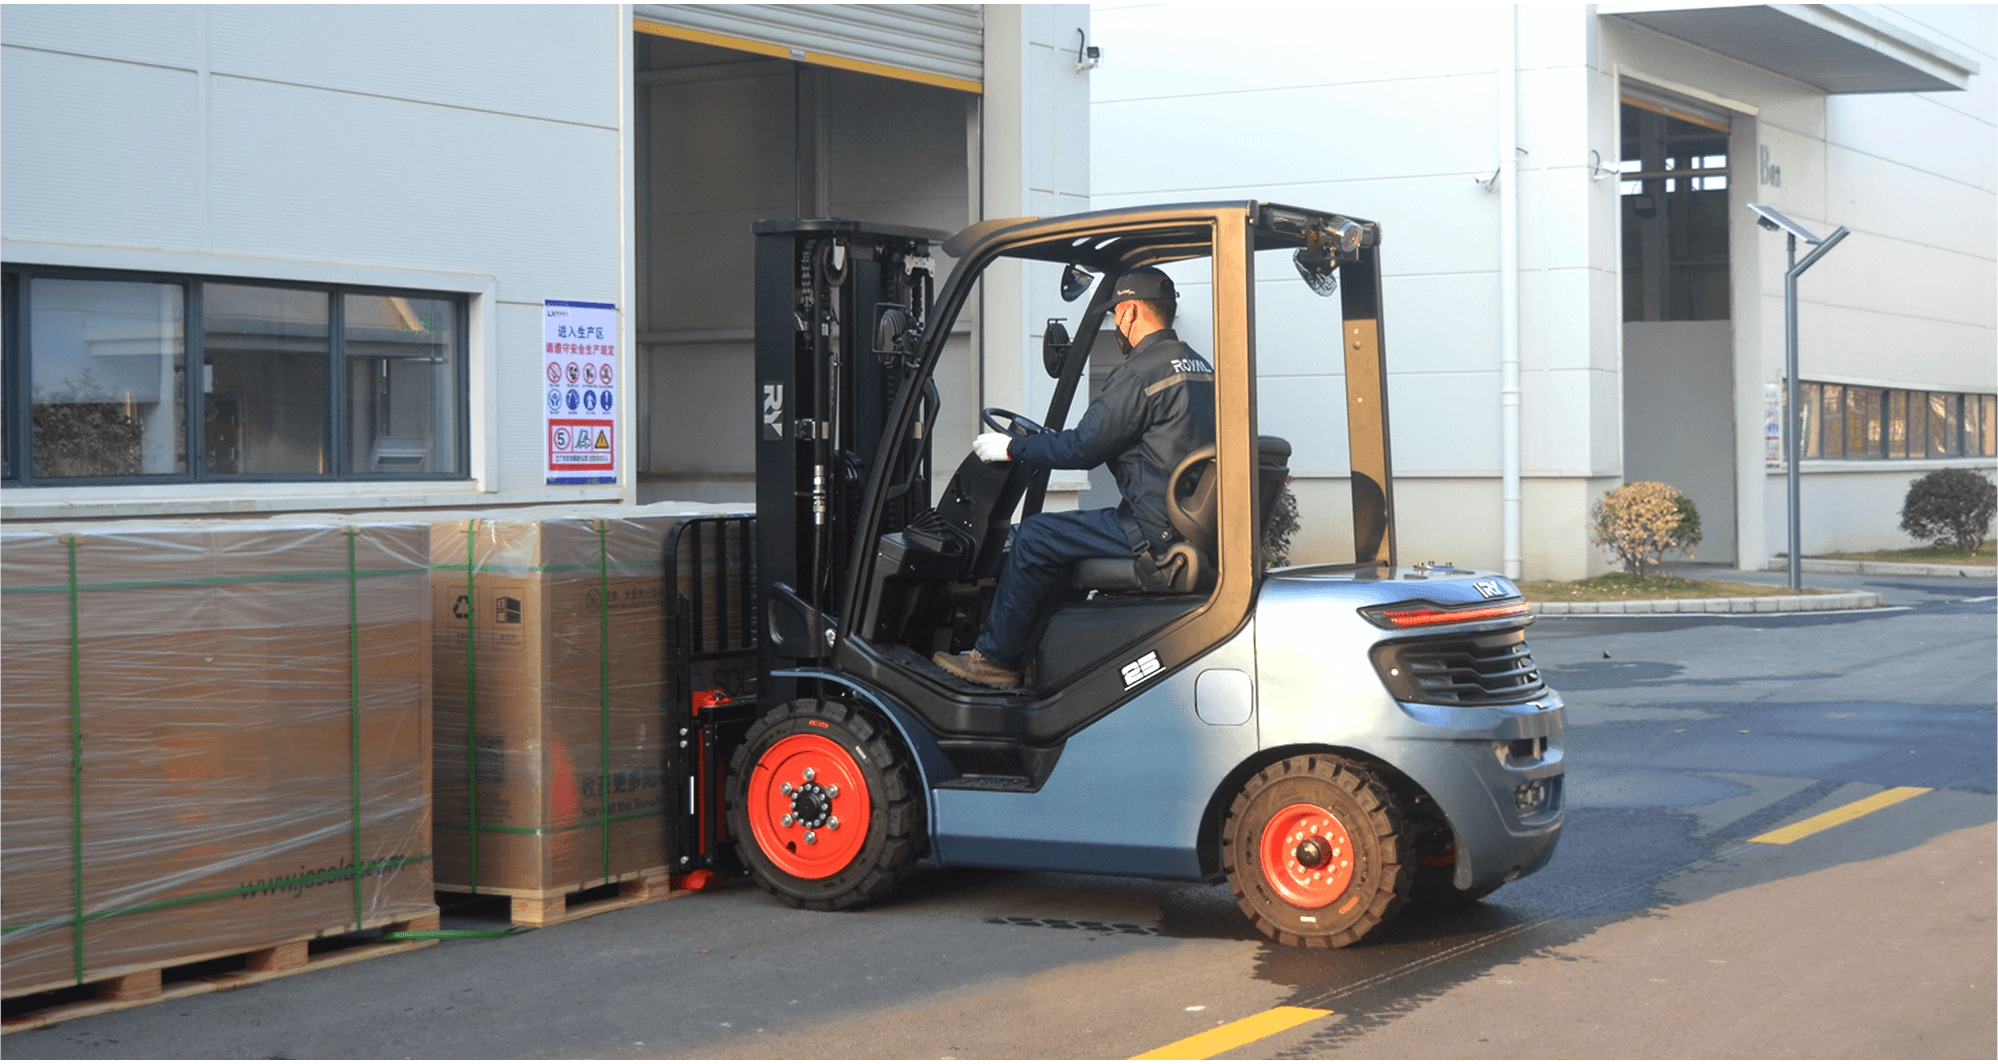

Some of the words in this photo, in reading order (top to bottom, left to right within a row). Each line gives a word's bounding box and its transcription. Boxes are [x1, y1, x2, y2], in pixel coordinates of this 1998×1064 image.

[558, 325, 604, 340] 进入生产区
[1170, 358, 1213, 373] ROYAL
[763, 384, 783, 437] RY
[557, 432, 566, 446] 5
[1121, 651, 1160, 686] 25
[240, 854, 405, 899] www.jasola.com
